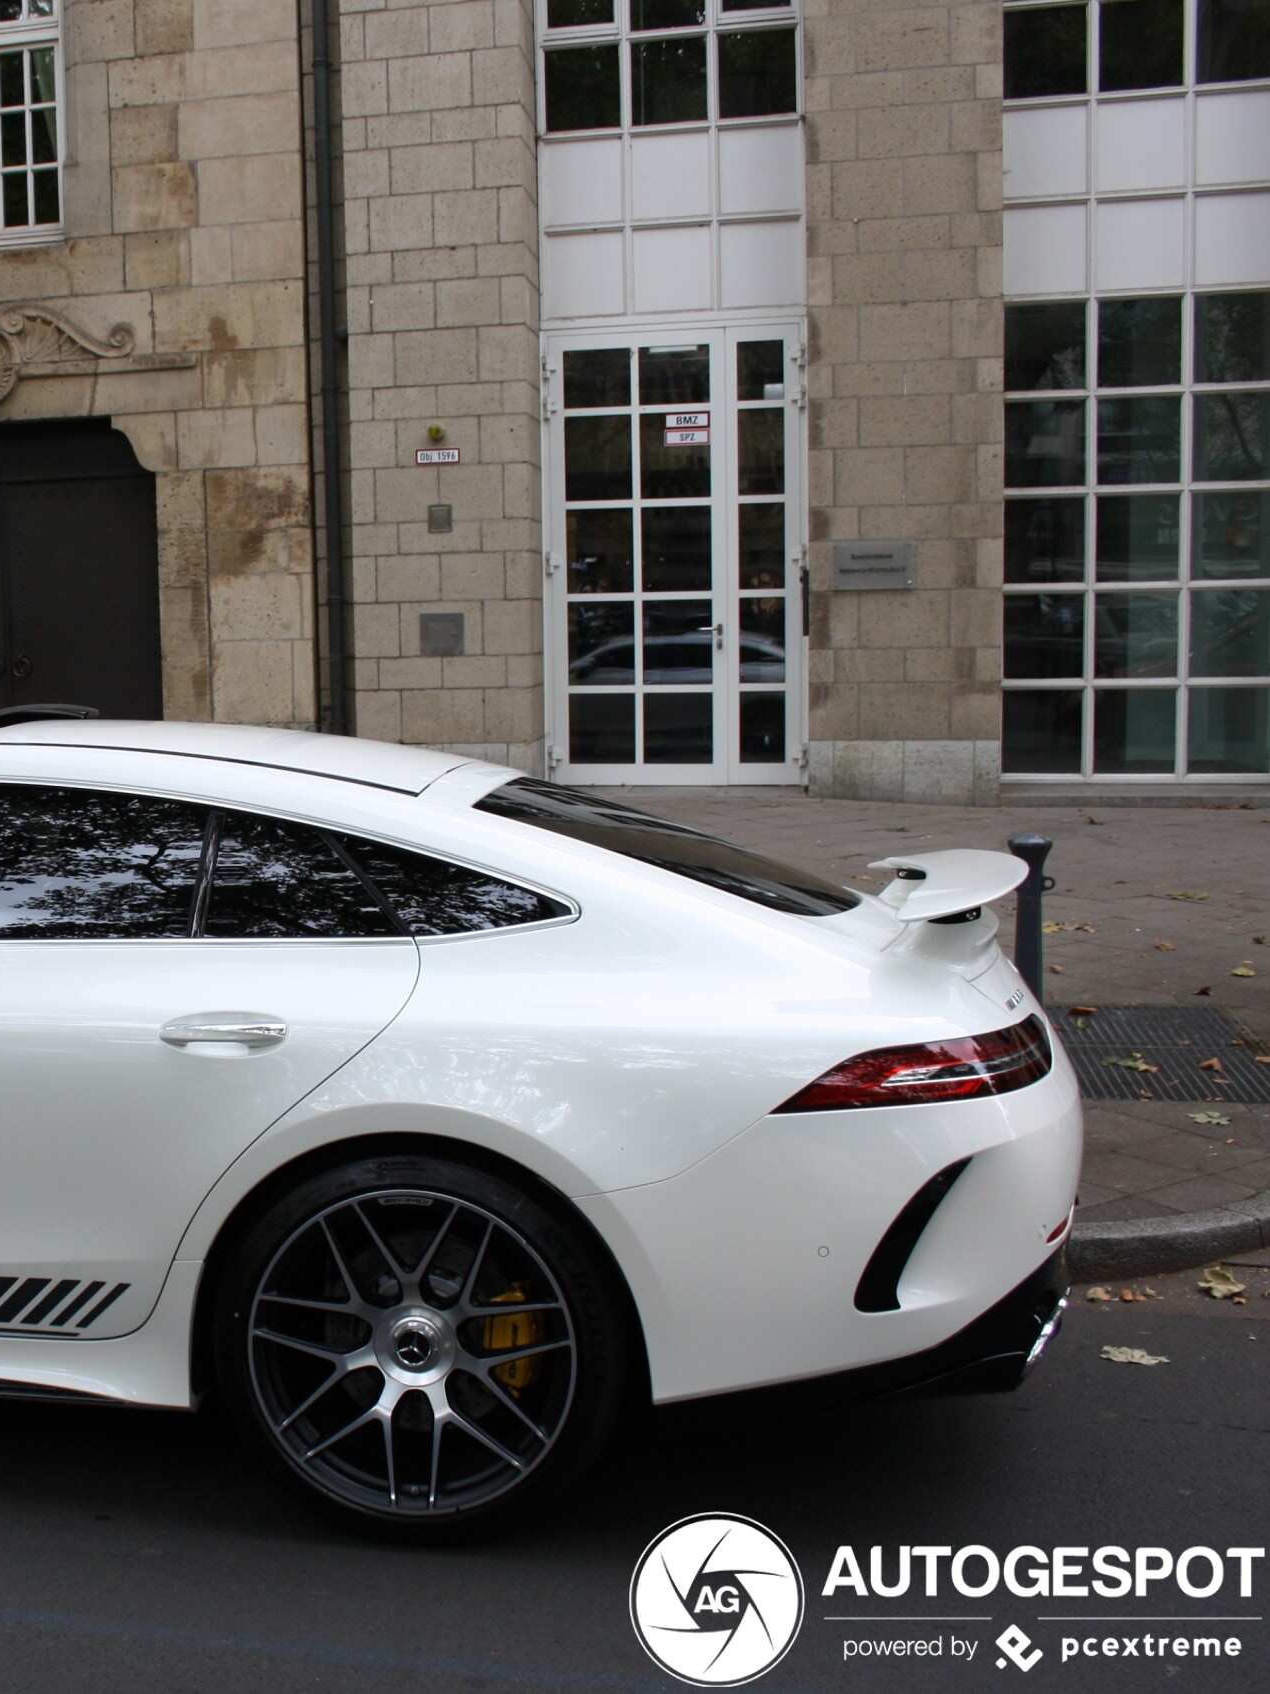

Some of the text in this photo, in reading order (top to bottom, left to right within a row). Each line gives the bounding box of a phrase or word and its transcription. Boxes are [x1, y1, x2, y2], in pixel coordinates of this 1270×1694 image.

[676, 415, 698, 425] BMZ
[679, 433, 695, 441] SPZ
[437, 451, 456, 461] 1596
